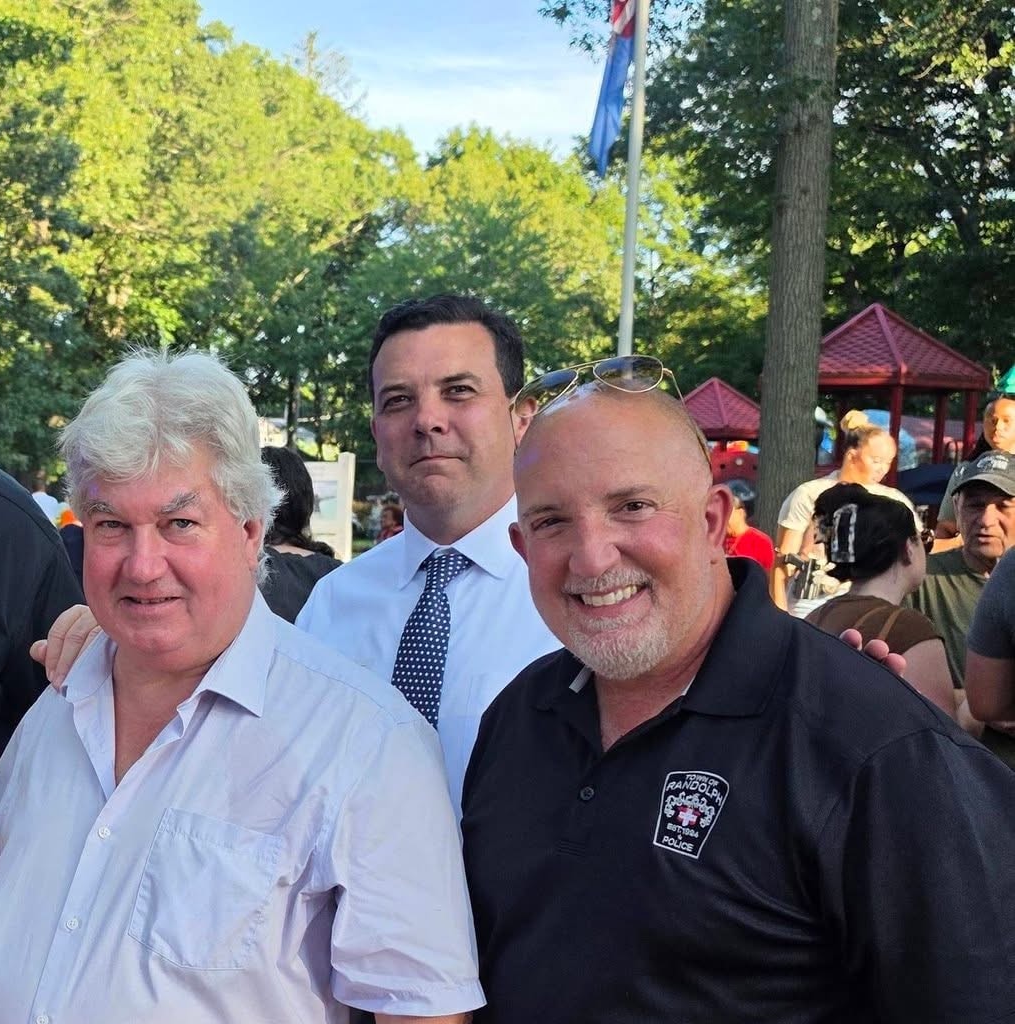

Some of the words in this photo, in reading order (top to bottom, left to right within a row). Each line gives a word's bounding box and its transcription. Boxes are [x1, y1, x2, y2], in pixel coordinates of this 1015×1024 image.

[685, 774, 708, 782] TOWN
[708, 779, 720, 787] OF
[666, 781, 723, 806] RANDOLPH
[662, 835, 694, 852] POLICE
